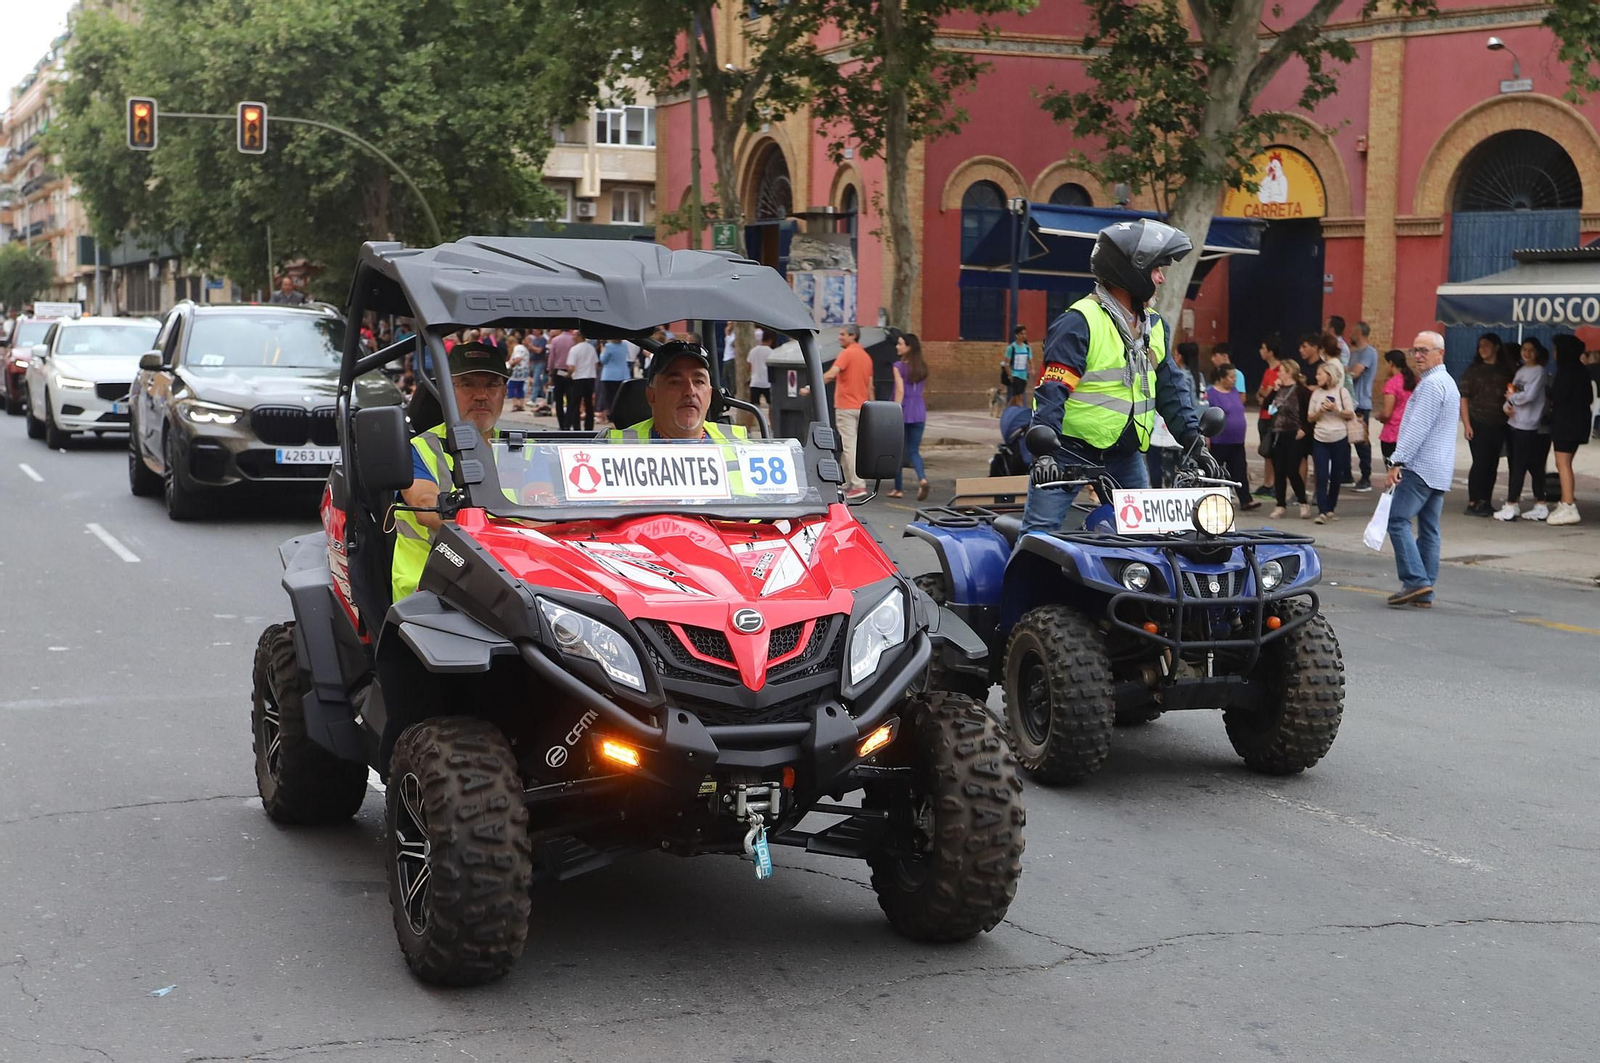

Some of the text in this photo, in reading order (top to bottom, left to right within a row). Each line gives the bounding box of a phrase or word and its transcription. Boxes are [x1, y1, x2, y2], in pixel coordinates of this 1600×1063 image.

[1244, 202, 1302, 218] CARRETA
[465, 295, 605, 312] CFMOTO
[1512, 297, 1600, 323] KIOSCO
[285, 450, 315, 462] 4263
[602, 456, 719, 487] EMIGRANTES
[749, 456, 787, 485] 58
[1143, 499, 1196, 523] EMIGRA
[565, 709, 599, 746] CFM
